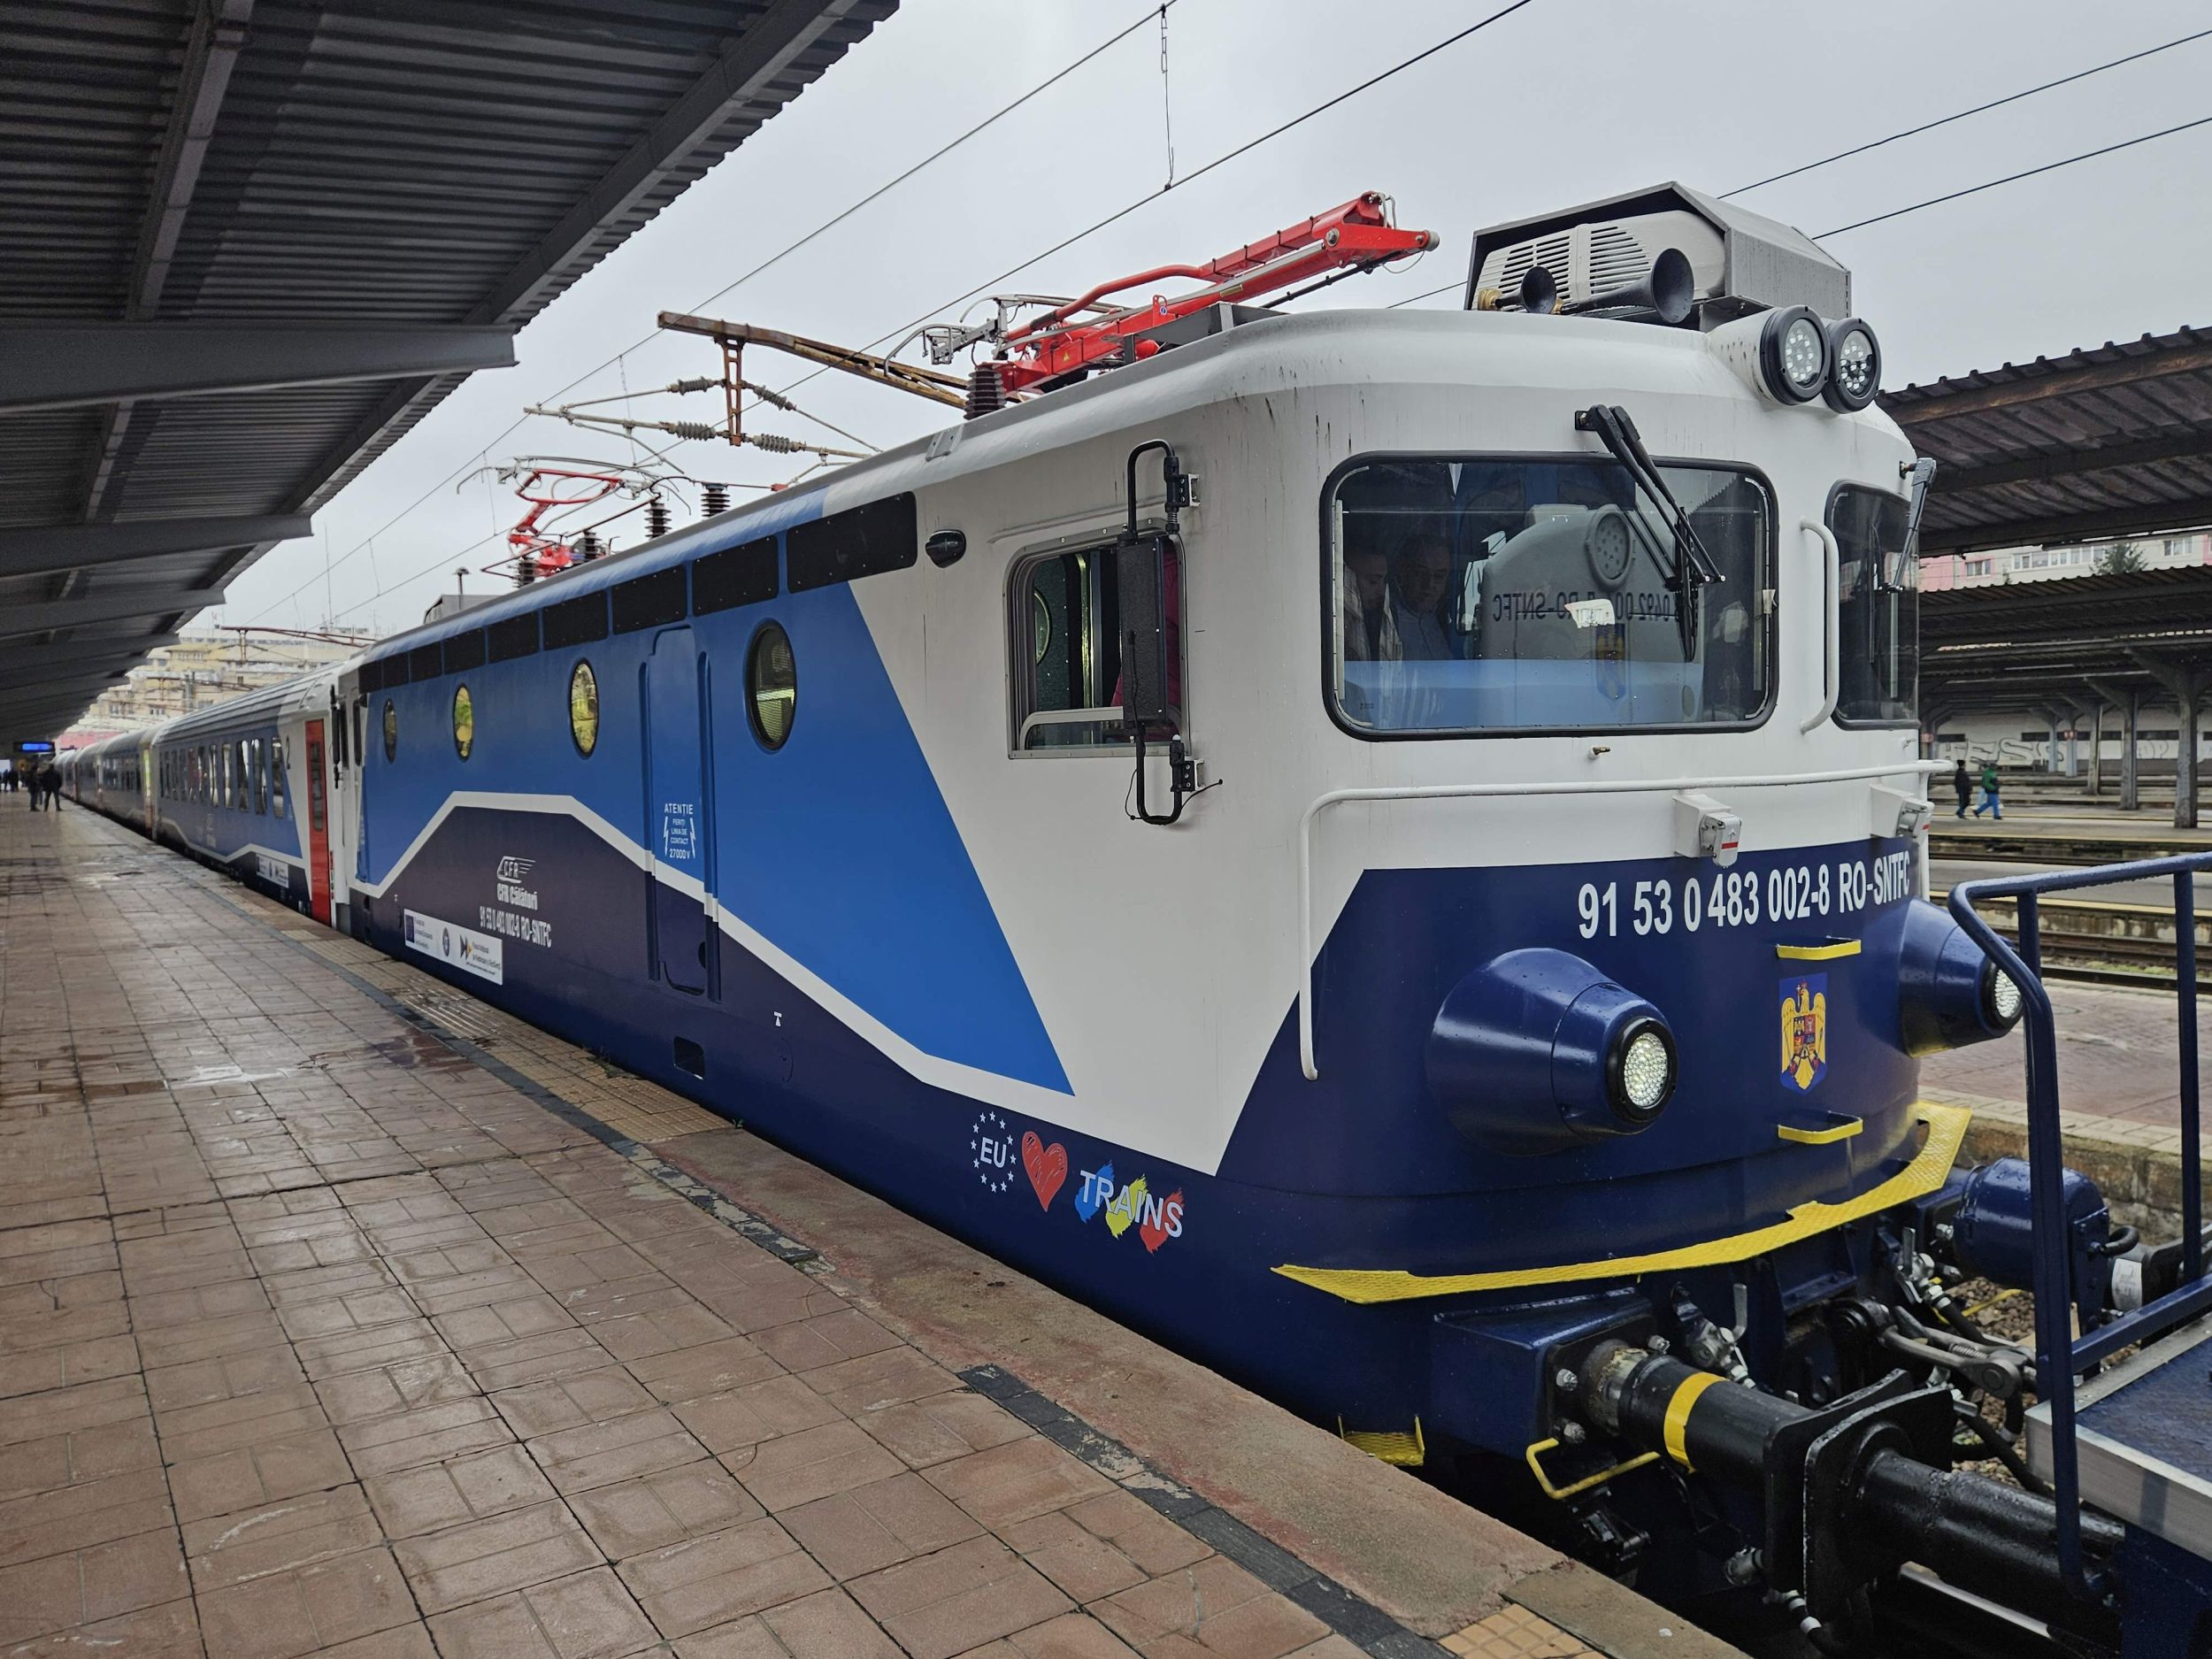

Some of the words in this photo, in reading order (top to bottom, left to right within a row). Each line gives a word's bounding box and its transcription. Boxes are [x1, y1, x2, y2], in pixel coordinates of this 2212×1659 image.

[503, 861, 519, 879] CFR
[1578, 882, 1617, 939] 91
[1633, 879, 1672, 935] 53
[1684, 878, 1701, 932] 0
[1708, 871, 1759, 926] 483
[1768, 864, 1830, 922] 002-8
[1839, 850, 1910, 912] RO-SNTFC
[979, 1136, 1007, 1168] EU
[1079, 1170, 1184, 1239] TRAINS
